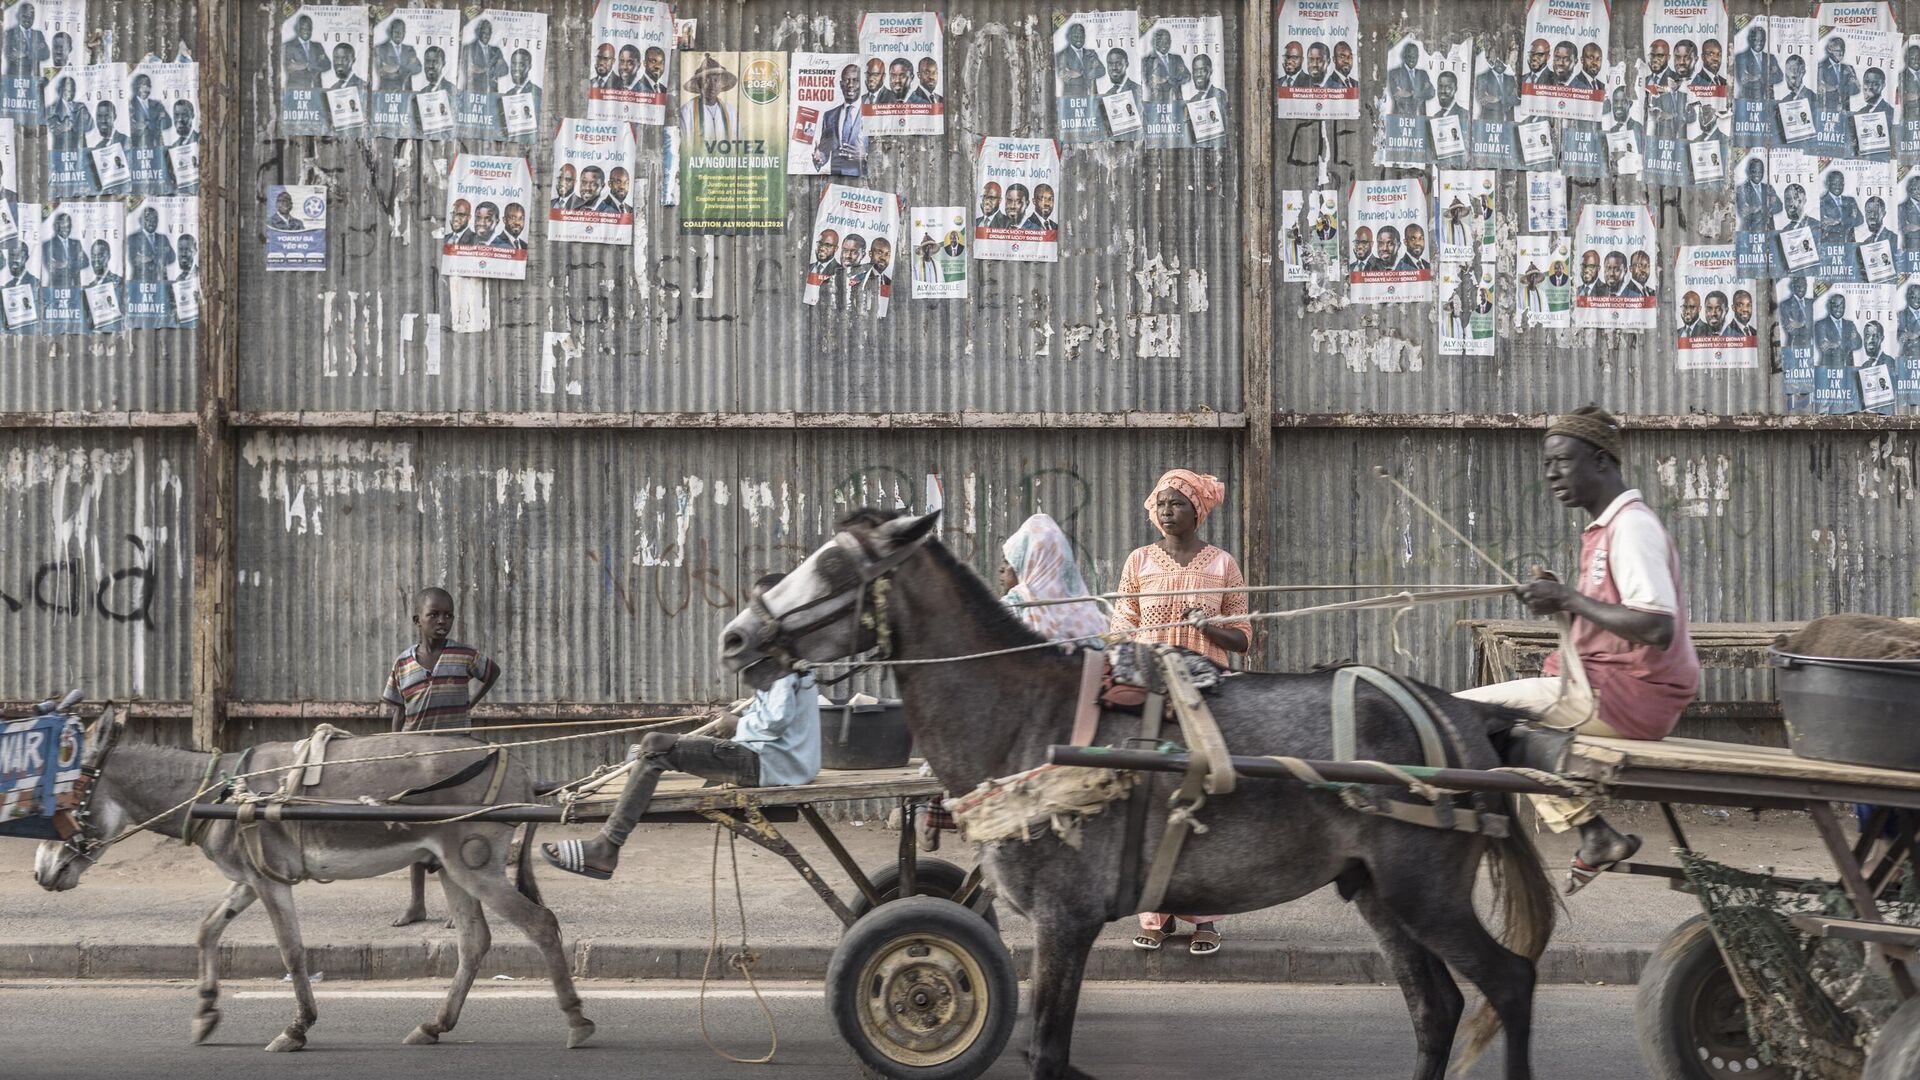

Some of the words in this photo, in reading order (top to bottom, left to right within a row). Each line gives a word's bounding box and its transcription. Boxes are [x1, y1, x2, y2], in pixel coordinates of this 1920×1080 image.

[612, 3, 655, 14] DIOMAYE
[1549, 0, 1590, 10] DIOMAYE
[1833, 8, 1877, 16] DIOMAYE
[44, 21, 81, 33] VOTE
[879, 18, 923, 26] DIOMAYE
[323, 32, 365, 42] VOTE
[415, 36, 454, 46] VOTE
[502, 38, 541, 49] VOTE
[1096, 38, 1135, 48] VOTE
[1182, 44, 1220, 54] VOTE
[1776, 45, 1814, 55] VOTE
[1428, 61, 1466, 72] VOTE
[1855, 56, 1895, 69] VOTE
[13, 78, 30, 89] DEM
[798, 76, 835, 88] MALICK
[17, 89, 26, 99] AK
[86, 90, 124, 101] VOTE
[293, 90, 312, 100] DEM
[384, 93, 402, 103] DEM
[469, 94, 487, 104] DEM
[798, 89, 835, 101] GAKOU
[297, 101, 308, 109] AK
[388, 103, 399, 112] AK
[1070, 98, 1087, 108] DEM
[1746, 101, 1763, 111] DEM
[472, 104, 483, 113] AK
[1074, 108, 1085, 117] AK
[1156, 104, 1173, 113] DEM
[1160, 114, 1170, 123] AK
[1820, 112, 1840, 122] DEM
[1399, 118, 1416, 128] DEM
[1485, 123, 1502, 133] DEM
[1823, 123, 1835, 132] AK
[575, 124, 617, 134] DIOMAYE
[1402, 128, 1413, 136] AK
[1488, 134, 1500, 143] AK
[1574, 132, 1591, 142] DEM
[1817, 132, 1845, 143] OMAYE
[705, 140, 765, 154] VOTEZ
[999, 143, 1040, 151] DIOMAYE
[1578, 142, 1588, 152] AK
[1658, 140, 1675, 150] DEM
[61, 152, 77, 161] DEM
[137, 150, 154, 160] DEM
[1661, 151, 1672, 160] AK
[64, 161, 75, 171] AK
[141, 160, 151, 168] AK
[470, 160, 512, 170] DIOMAYE
[689, 156, 704, 168] ALY
[749, 156, 779, 168] NDIAYE
[132, 169, 163, 180] IOMAYE
[1774, 173, 1814, 184] VOTE
[1366, 185, 1407, 194] DIOMAYE
[1856, 186, 1893, 196] VOTE
[841, 191, 884, 205] DIOMAYE
[1749, 233, 1765, 243] DEM
[1752, 244, 1763, 253] AK
[1827, 246, 1845, 255] DEM
[1831, 256, 1843, 265] AK
[139, 283, 157, 292] DEM
[54, 288, 71, 299] DEM
[143, 293, 154, 303] AK
[58, 299, 68, 308] AK
[1855, 310, 1893, 320] VOTE
[1794, 348, 1811, 358] DEM
[1798, 359, 1809, 368] AK
[1785, 368, 1815, 379] DIOMAY
[1827, 369, 1844, 378] DEM
[1830, 379, 1840, 389] AK
